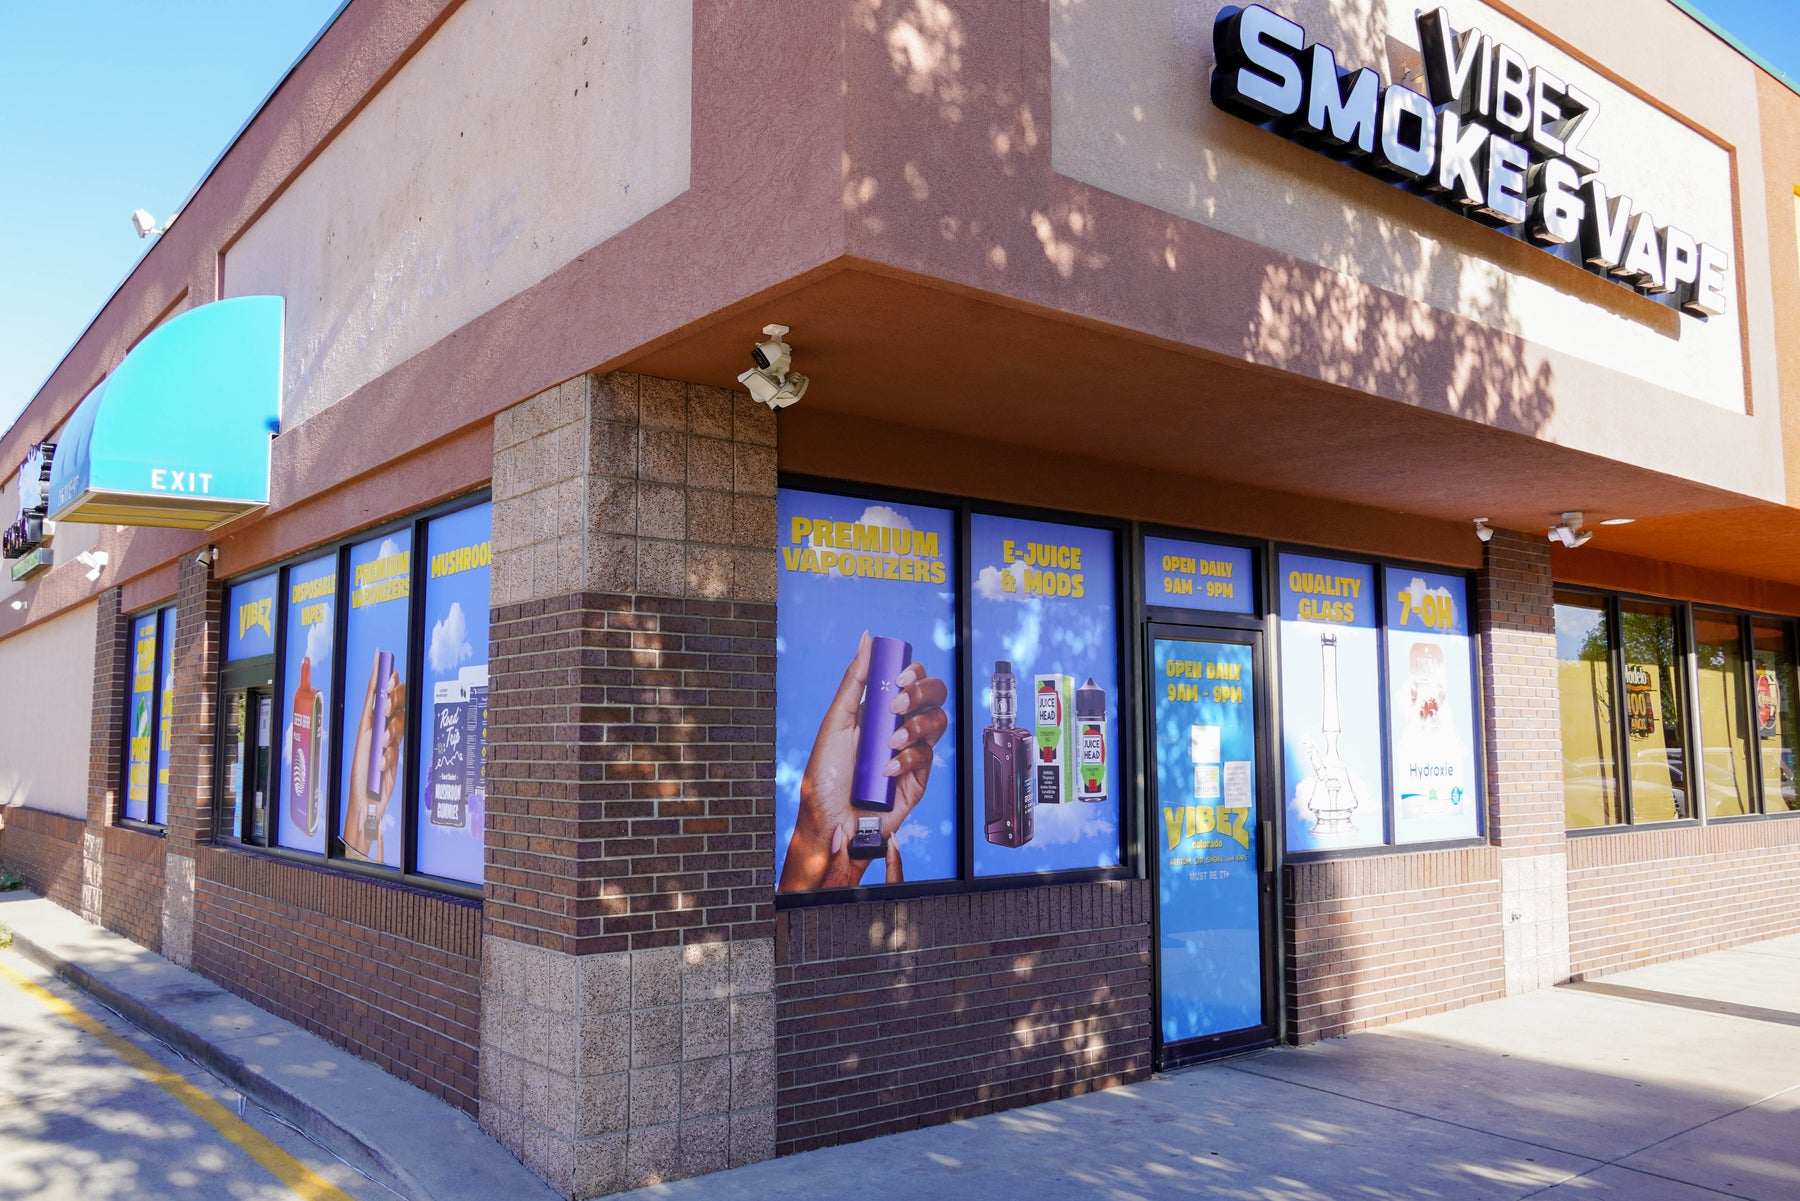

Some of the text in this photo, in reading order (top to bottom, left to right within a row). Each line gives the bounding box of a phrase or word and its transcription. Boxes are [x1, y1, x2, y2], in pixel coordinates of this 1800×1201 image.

[1436, 6, 1600, 172] VIBEZ
[1234, 3, 1729, 316] SMOKE & VAPE
[152, 468, 213, 494] EXIT
[791, 516, 939, 559] PREMIUM
[355, 551, 410, 587] PREMIUM
[431, 541, 492, 579] MUSHROO
[782, 546, 946, 585] VAPORIZERS
[1003, 540, 1082, 570] E-JUICE
[1162, 555, 1233, 578] OPEN DAILY
[292, 573, 336, 604] DISPOSABLE
[352, 575, 410, 610] VAPORIZERS
[1001, 568, 1084, 598] & MODS
[1164, 576, 1193, 596] 9AM
[1206, 581, 1233, 599] 9PM
[1289, 570, 1362, 600] QUALITY
[239, 597, 272, 640] VIBEZ
[301, 603, 324, 626] VAPES
[1298, 597, 1355, 624] GLASS
[1397, 591, 1452, 629] 7-OH
[1166, 660, 1242, 681] OPEN DAILY
[1039, 697, 1055, 708] JUICE
[1167, 684, 1198, 703] 9AM
[1213, 686, 1243, 704] 9PM
[1039, 710, 1056, 721] HEAD
[1083, 739, 1100, 749] JUICE
[1083, 750, 1101, 760] HEAD
[1409, 762, 1454, 781] Hydroxie
[1164, 805, 1249, 851] VIBEZ
[1189, 871, 1207, 881] MUST
[1209, 870, 1218, 880] BE
